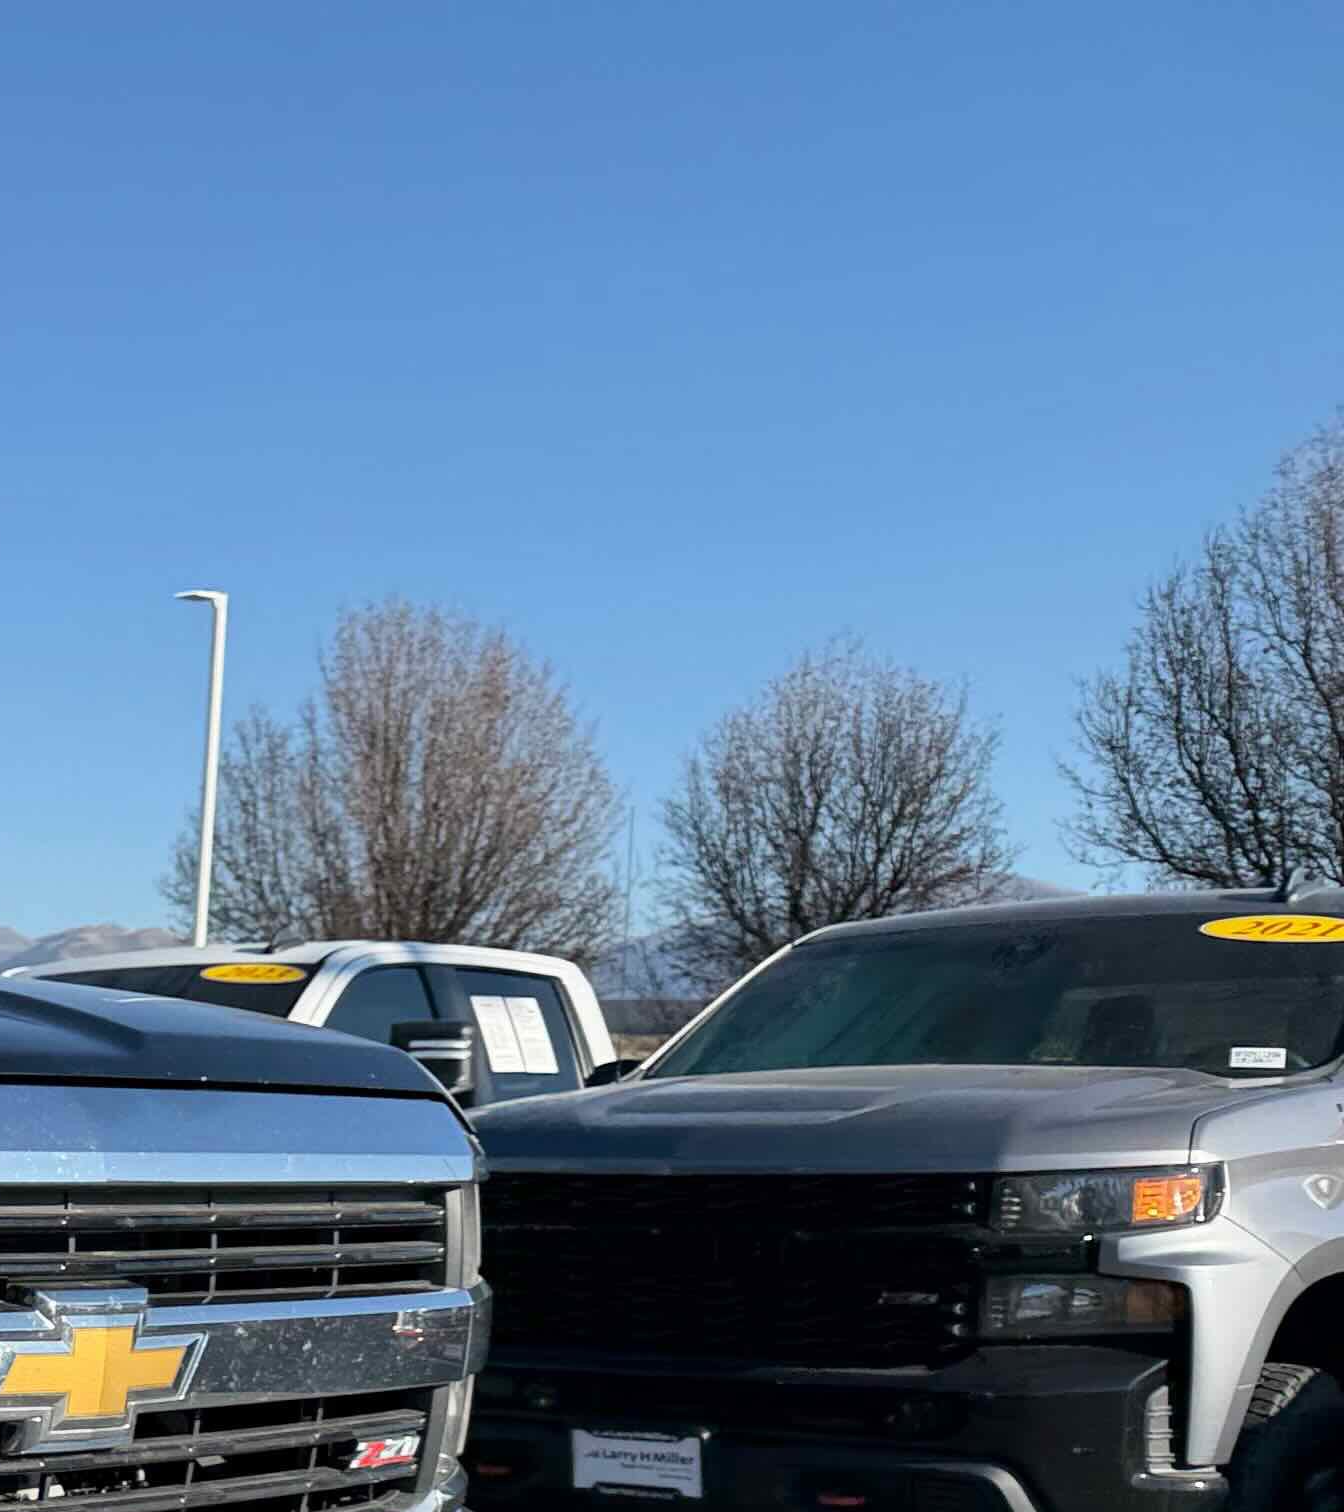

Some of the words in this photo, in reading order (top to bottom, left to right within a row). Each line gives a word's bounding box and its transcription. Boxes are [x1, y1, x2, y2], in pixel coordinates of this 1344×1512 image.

[1231, 920, 1344, 937] 2021
[350, 1435, 421, 1469] Z71
[602, 1447, 638, 1462] Larry
[653, 1451, 695, 1465] Miller
